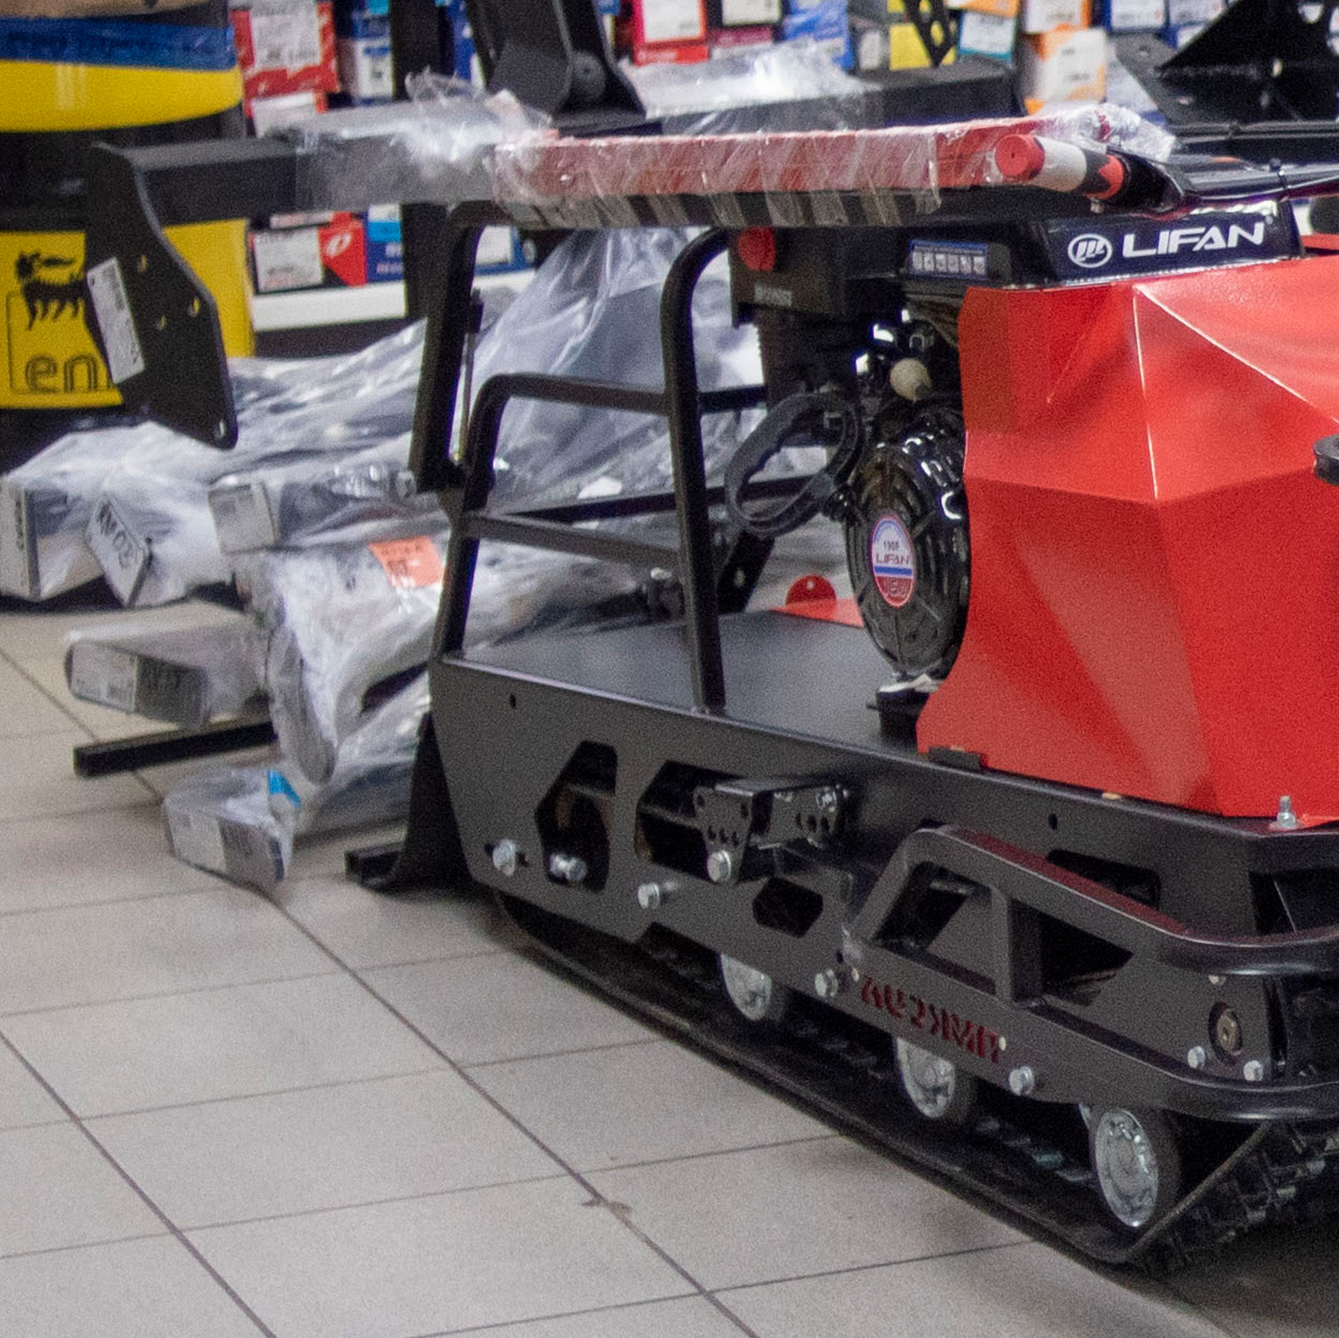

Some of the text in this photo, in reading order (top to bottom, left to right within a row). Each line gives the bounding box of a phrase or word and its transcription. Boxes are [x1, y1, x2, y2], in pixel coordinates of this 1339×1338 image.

[1121, 221, 1266, 259] LIFAN
[25, 353, 113, 395] en
[875, 552, 911, 565] LIFAN
